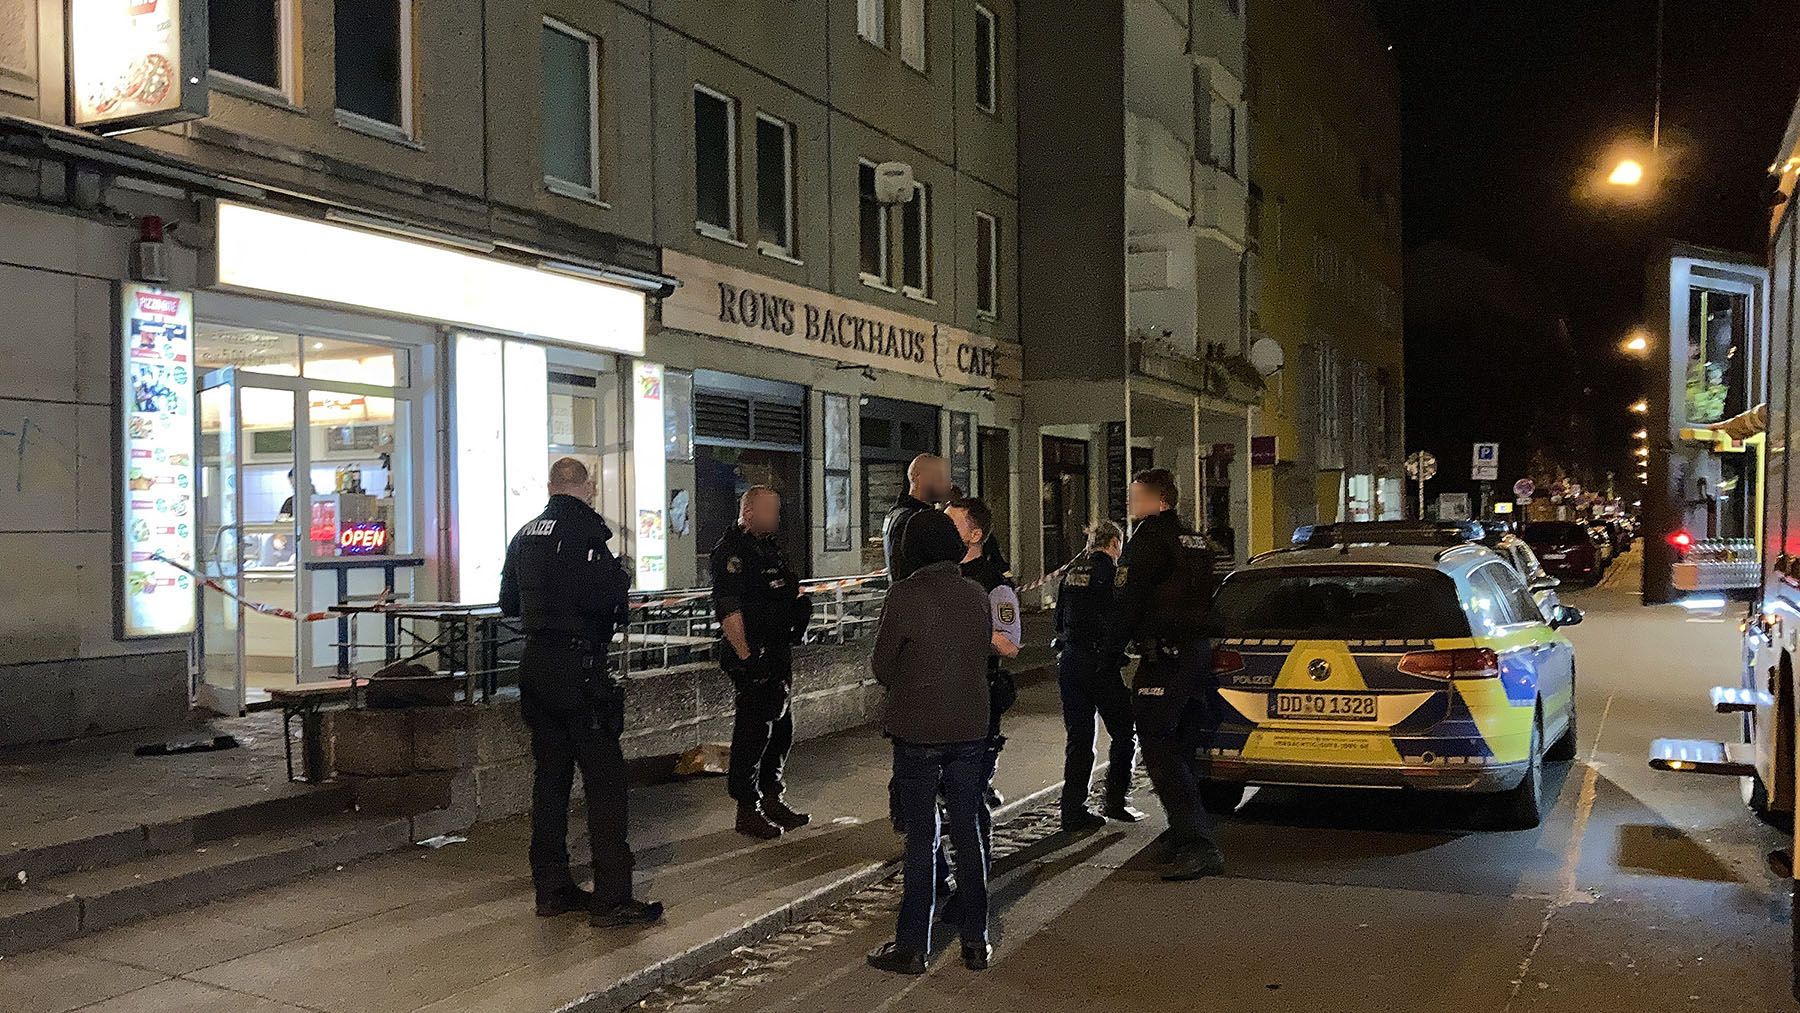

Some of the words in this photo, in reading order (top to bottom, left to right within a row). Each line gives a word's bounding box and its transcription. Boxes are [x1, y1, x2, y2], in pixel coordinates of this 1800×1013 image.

[718, 282, 795, 336] RONS
[804, 303, 925, 363] BACKHAUS
[341, 528, 385, 547] OPEN
[1232, 675, 1272, 685] POLIZEI
[1280, 696, 1301, 712] DD
[1314, 697, 1325, 713] Q
[1329, 696, 1374, 714] 1328
